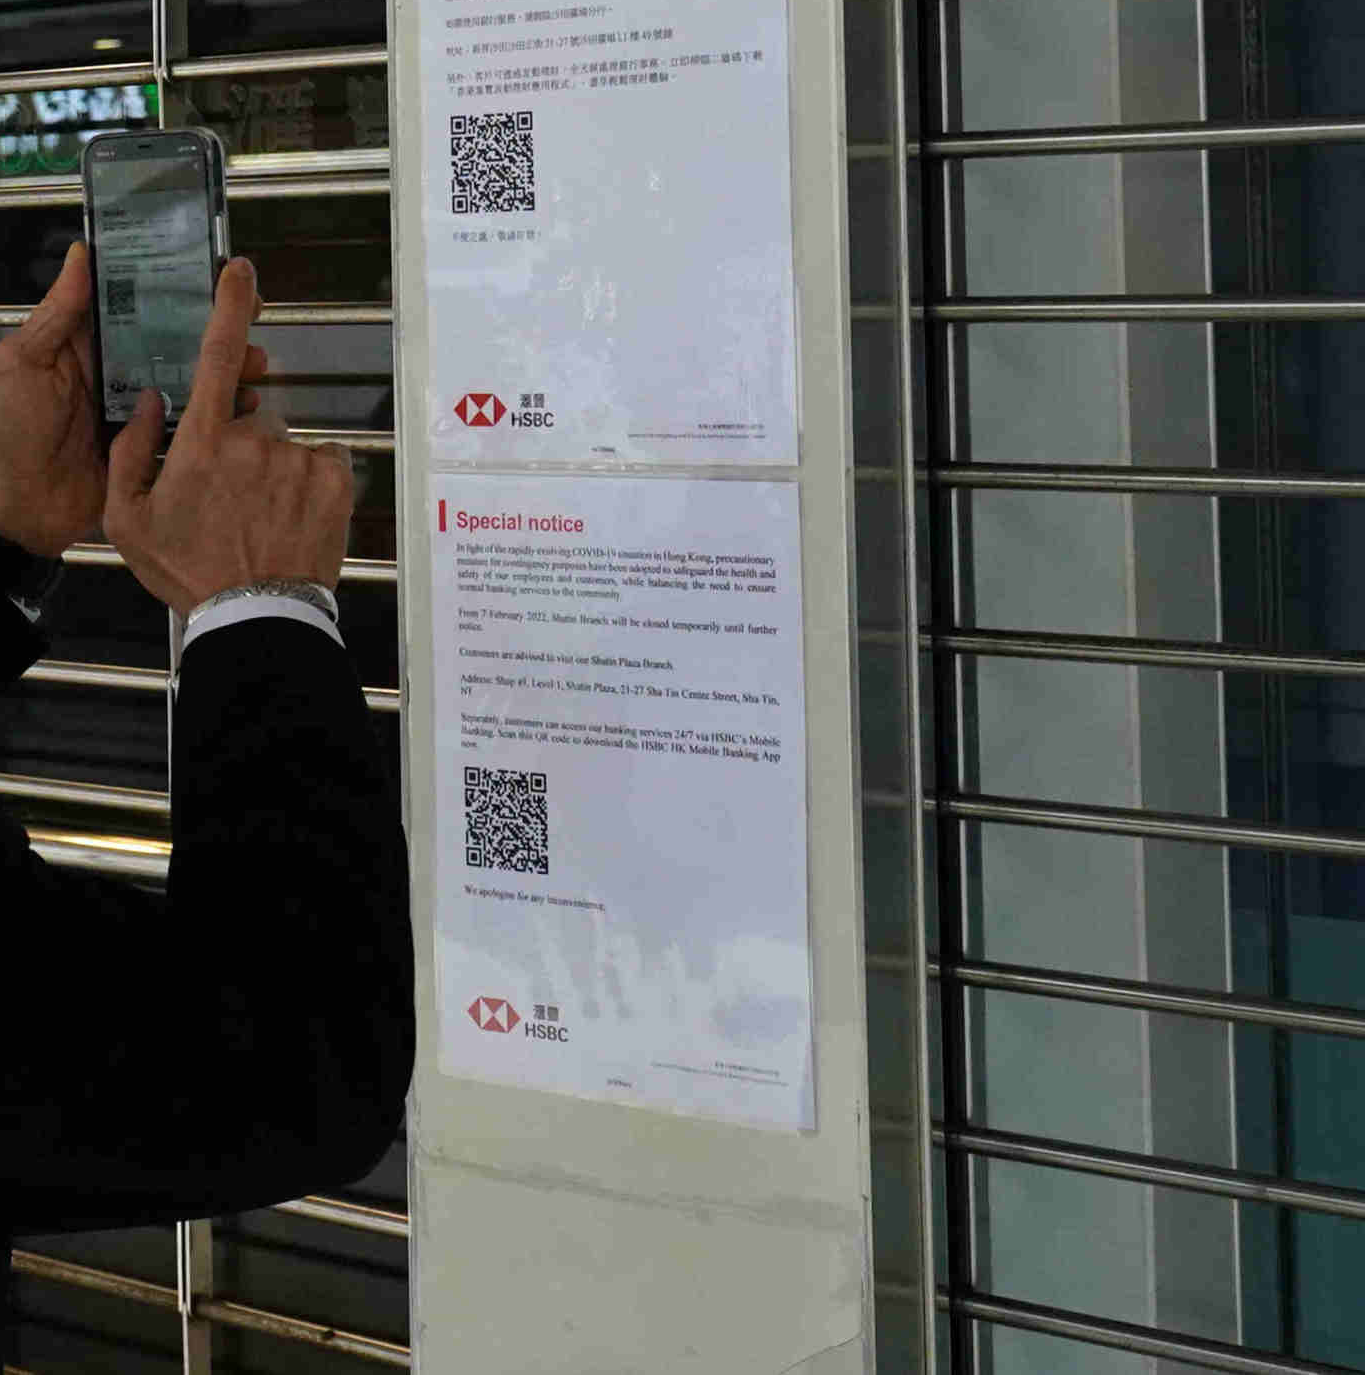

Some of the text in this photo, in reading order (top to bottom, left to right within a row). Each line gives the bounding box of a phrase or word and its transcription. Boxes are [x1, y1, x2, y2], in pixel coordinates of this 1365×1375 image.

[511, 412, 554, 428] HSBC
[457, 511, 584, 535] Special notice
[715, 553, 774, 566] precautionary
[715, 567, 729, 577] the
[731, 567, 757, 578] health
[759, 568, 776, 578] and
[562, 587, 574, 597] the
[692, 579, 706, 590] the
[710, 581, 730, 591] need
[734, 581, 743, 591] to
[747, 584, 776, 593] ensure
[612, 616, 628, 627] will
[630, 617, 640, 627] be
[643, 618, 669, 629] closed
[672, 619, 720, 633] temporarily
[724, 622, 744, 633] until
[747, 624, 777, 635] further
[619, 657, 641, 668] Plaza
[495, 675, 515, 687] Shop
[532, 677, 554, 689] Level
[621, 684, 644, 695] 21-27
[646, 686, 662, 696] Sha
[665, 688, 679, 697] Tin
[712, 691, 741, 703] Street,
[742, 693, 758, 704] Sha
[762, 695, 780, 706] Tin,
[605, 724, 637, 738] banking
[639, 728, 672, 739] services
[674, 729, 694, 740] 24/7
[696, 732, 709, 742] via
[749, 735, 781, 747] Mobile
[519, 730, 533, 740] this
[535, 732, 549, 742] QR
[551, 734, 570, 744] code
[573, 736, 581, 745] to
[583, 736, 622, 748] download
[625, 738, 638, 749] the
[641, 741, 668, 752] HSBC
[671, 743, 686, 754] HK
[689, 744, 719, 756] Mobile
[722, 747, 759, 761] Banking
[762, 751, 781, 764] App
[525, 1023, 569, 1042] HSBC
